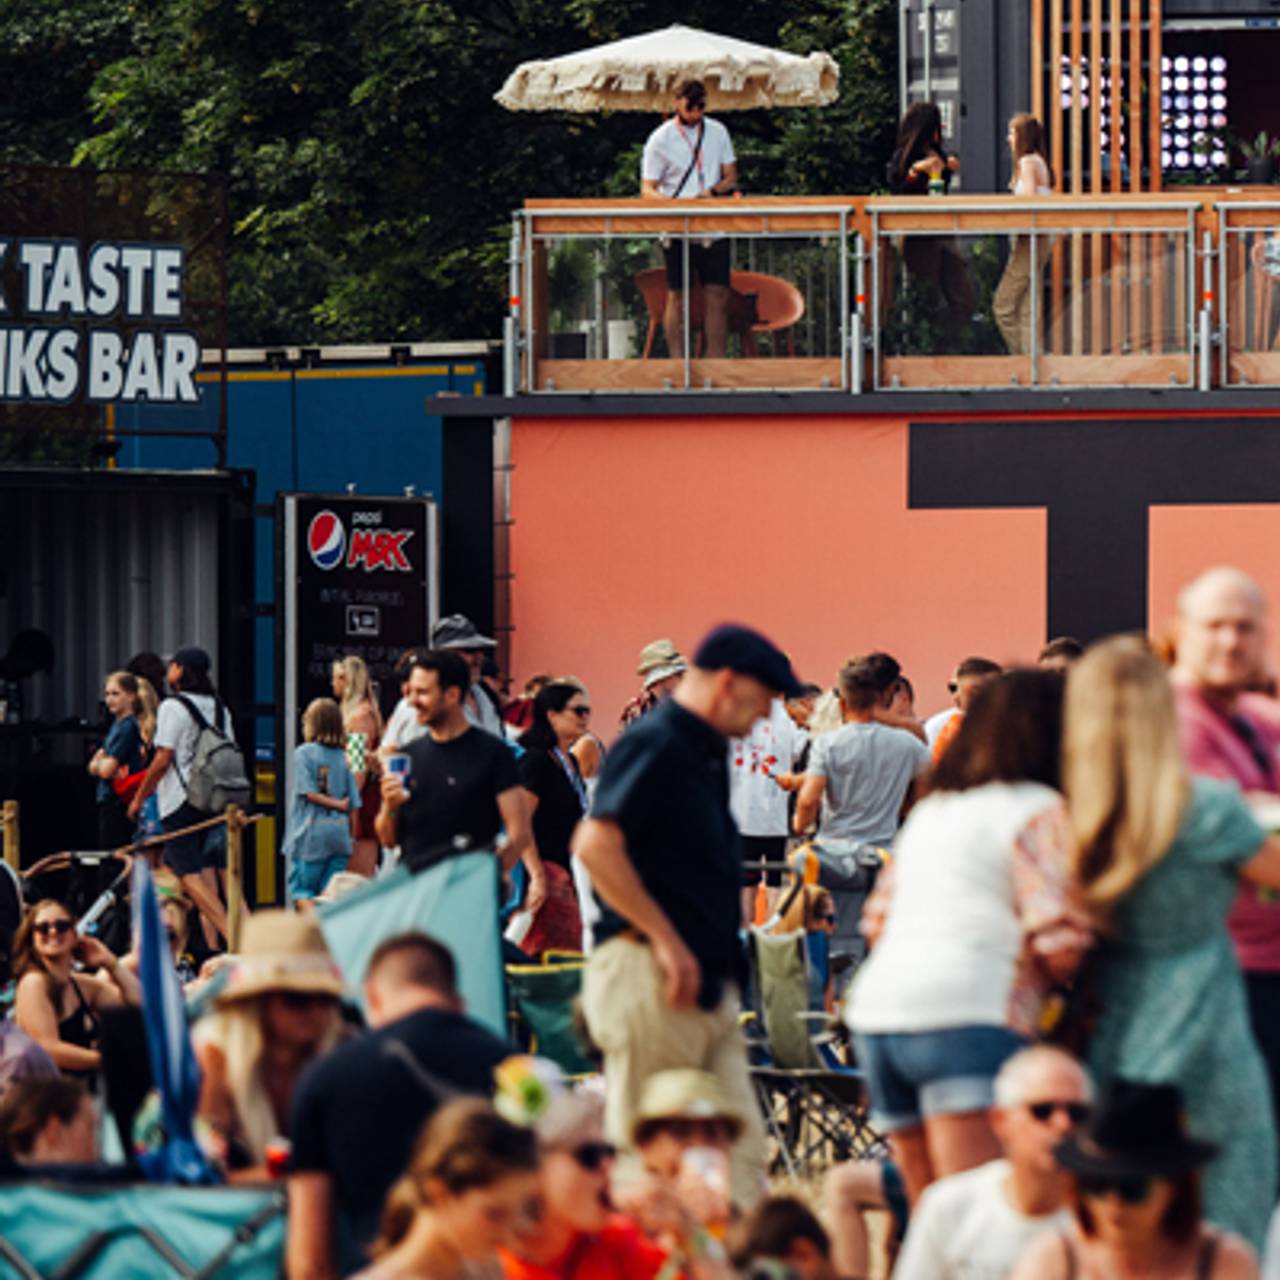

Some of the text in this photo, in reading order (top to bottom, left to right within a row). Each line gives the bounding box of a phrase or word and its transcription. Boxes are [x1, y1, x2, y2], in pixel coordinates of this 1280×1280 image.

[22, 244, 181, 315] TASTE
[90, 332, 198, 401] BAR
[346, 529, 415, 572] MAX
